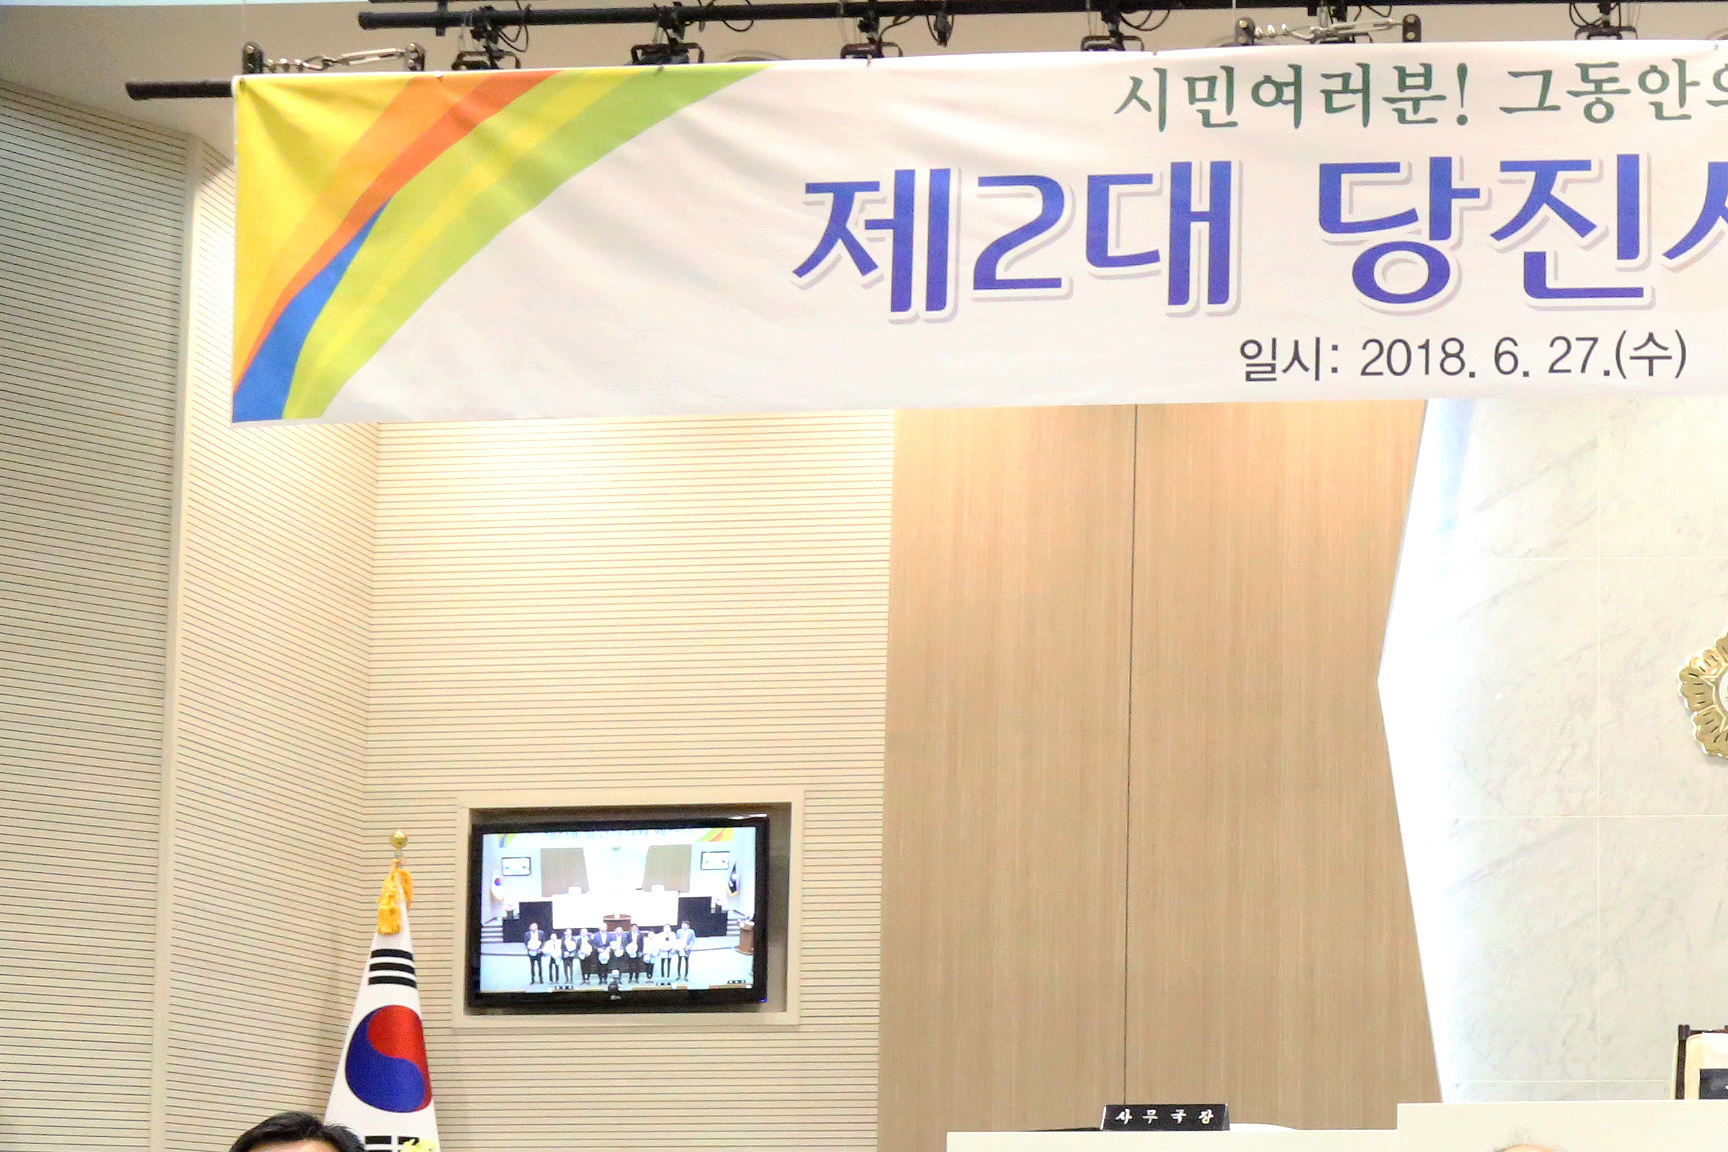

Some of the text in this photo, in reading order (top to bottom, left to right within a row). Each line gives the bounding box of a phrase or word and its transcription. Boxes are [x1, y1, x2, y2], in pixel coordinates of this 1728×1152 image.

[1116, 61, 1468, 131] 시민여러분!
[794, 160, 1234, 313] 제2대
[1239, 329, 1688, 383] 일시: 2018. 6. 27.(수)
